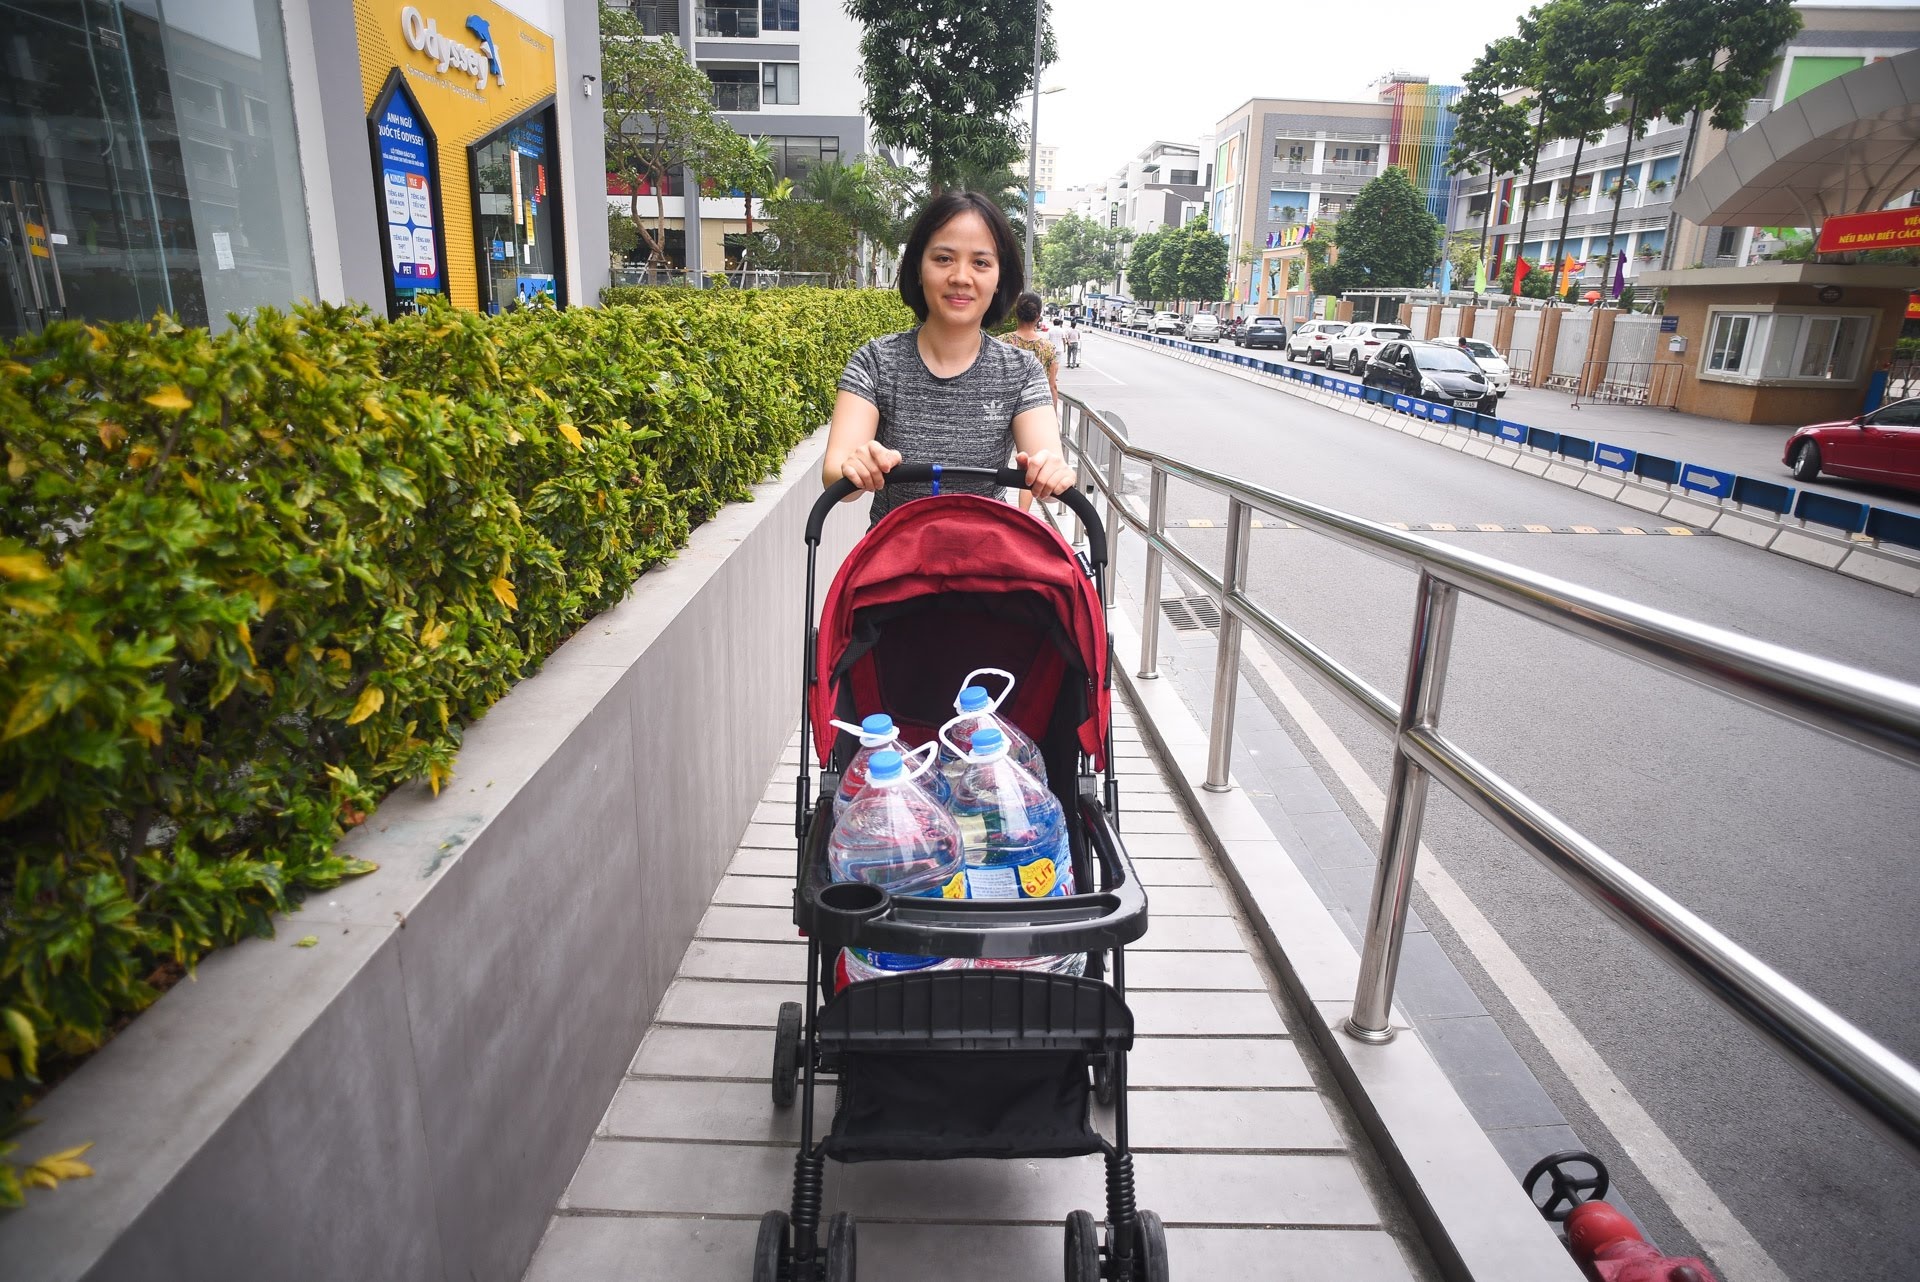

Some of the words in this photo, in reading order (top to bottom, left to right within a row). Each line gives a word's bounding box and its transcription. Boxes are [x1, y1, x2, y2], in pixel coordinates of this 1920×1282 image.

[401, 6, 489, 90] Odyssey
[387, 112, 400, 125] ANH
[400, 116, 413, 129] NGỮ
[401, 131, 424, 146] ODYSSEY
[1839, 232, 1856, 244] NẾU
[1856, 233, 1875, 243] BẠN
[1876, 229, 1896, 241] BIẾT
[403, 266, 412, 275] PET
[1026, 881, 1037, 894] 6
[875, 954, 881, 967] L
